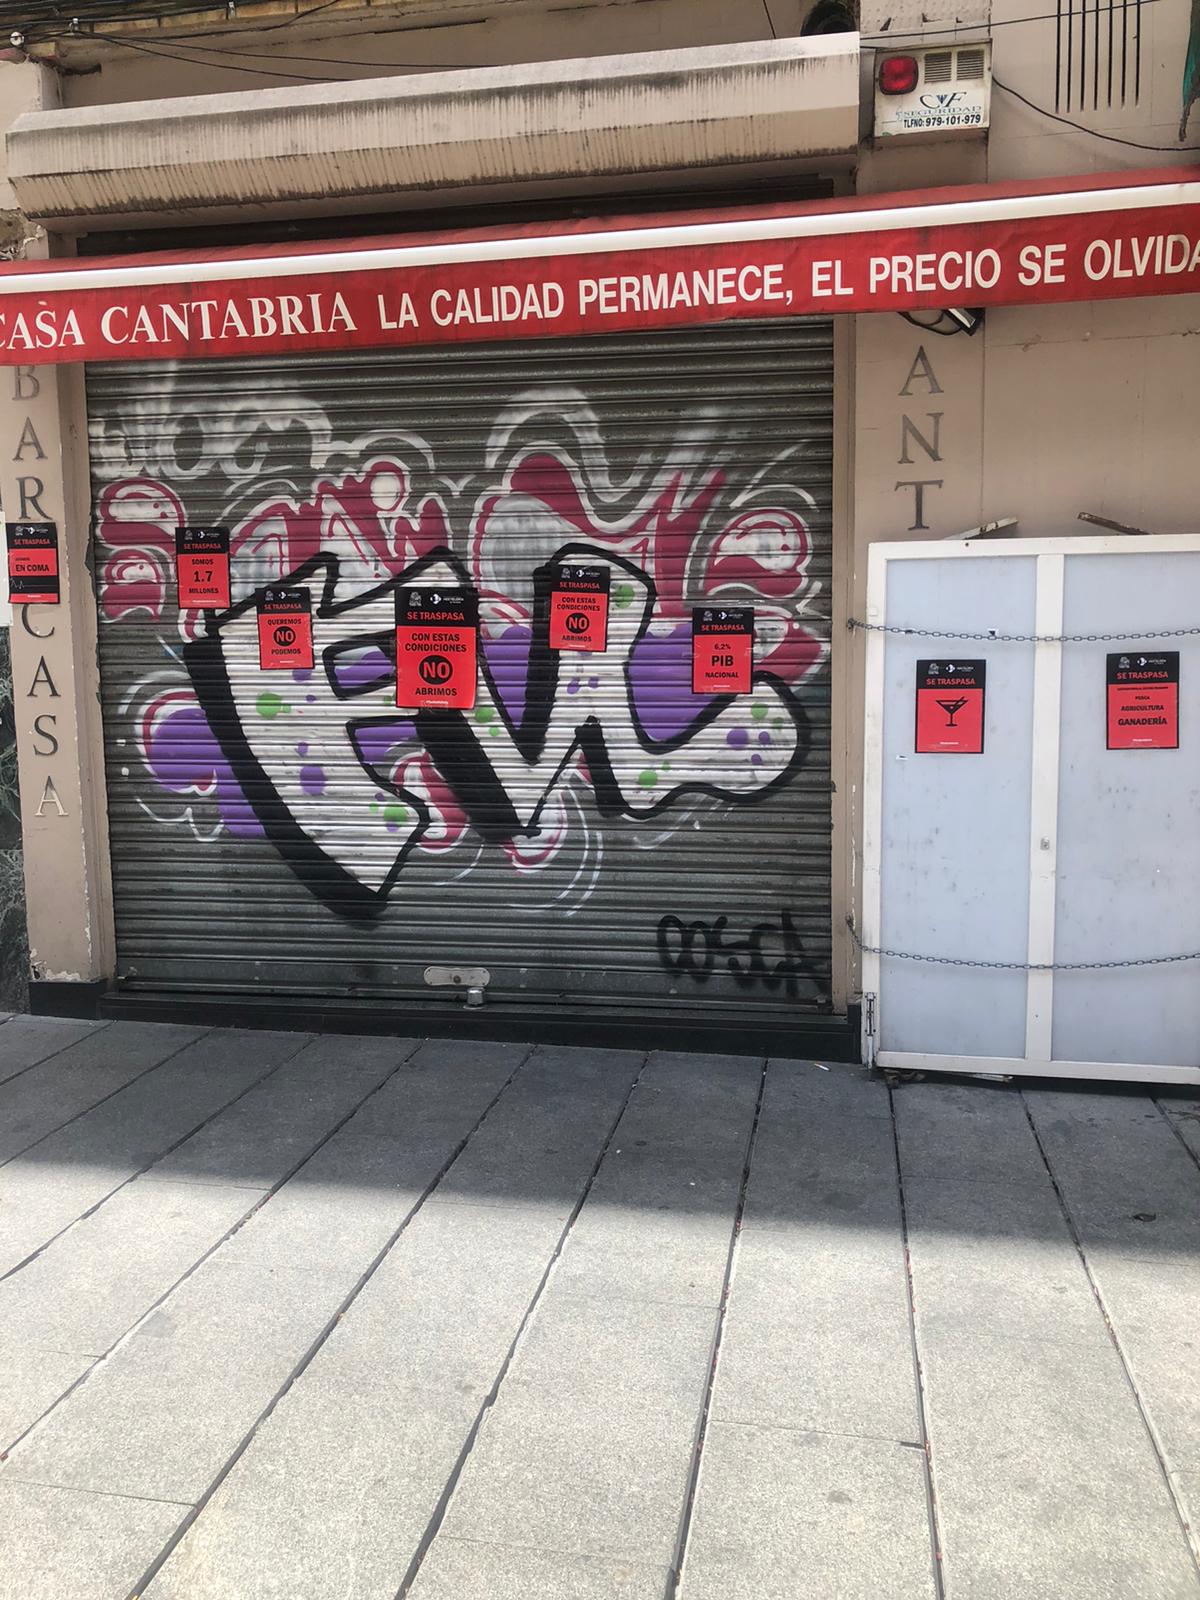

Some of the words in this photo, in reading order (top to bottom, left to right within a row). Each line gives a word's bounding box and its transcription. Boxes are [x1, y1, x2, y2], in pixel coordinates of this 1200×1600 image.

[926, 114, 981, 127] 979-101-979
[0, 309, 85, 350] ASA
[100, 291, 358, 345] CANTABRIA
[378, 293, 418, 330] LA
[430, 282, 563, 327] CALIDAD
[579, 263, 793, 316] PERMANECE,
[811, 260, 853, 298] EL
[869, 248, 1001, 294] PRECIO
[1018, 244, 1066, 286] SE
[15, 564, 25, 572] EN
[27, 564, 49, 572] COMA
[194, 571, 212, 582] 1.7
[557, 603, 600, 611] CONDICIONES
[407, 611, 417, 620] SE
[420, 611, 464, 620] TRASPASA
[569, 617, 587, 629] NO
[276, 630, 294, 642] NO
[411, 633, 430, 641] CON
[432, 633, 460, 642] ESTAS
[405, 643, 467, 652] CONDICIONES
[712, 655, 733, 666] PIB
[423, 661, 450, 678] NO
[1128, 671, 1168, 679] TRASPASA
[415, 687, 457, 696] ABRIMOS
[1118, 716, 1167, 726] GANADERÍA
